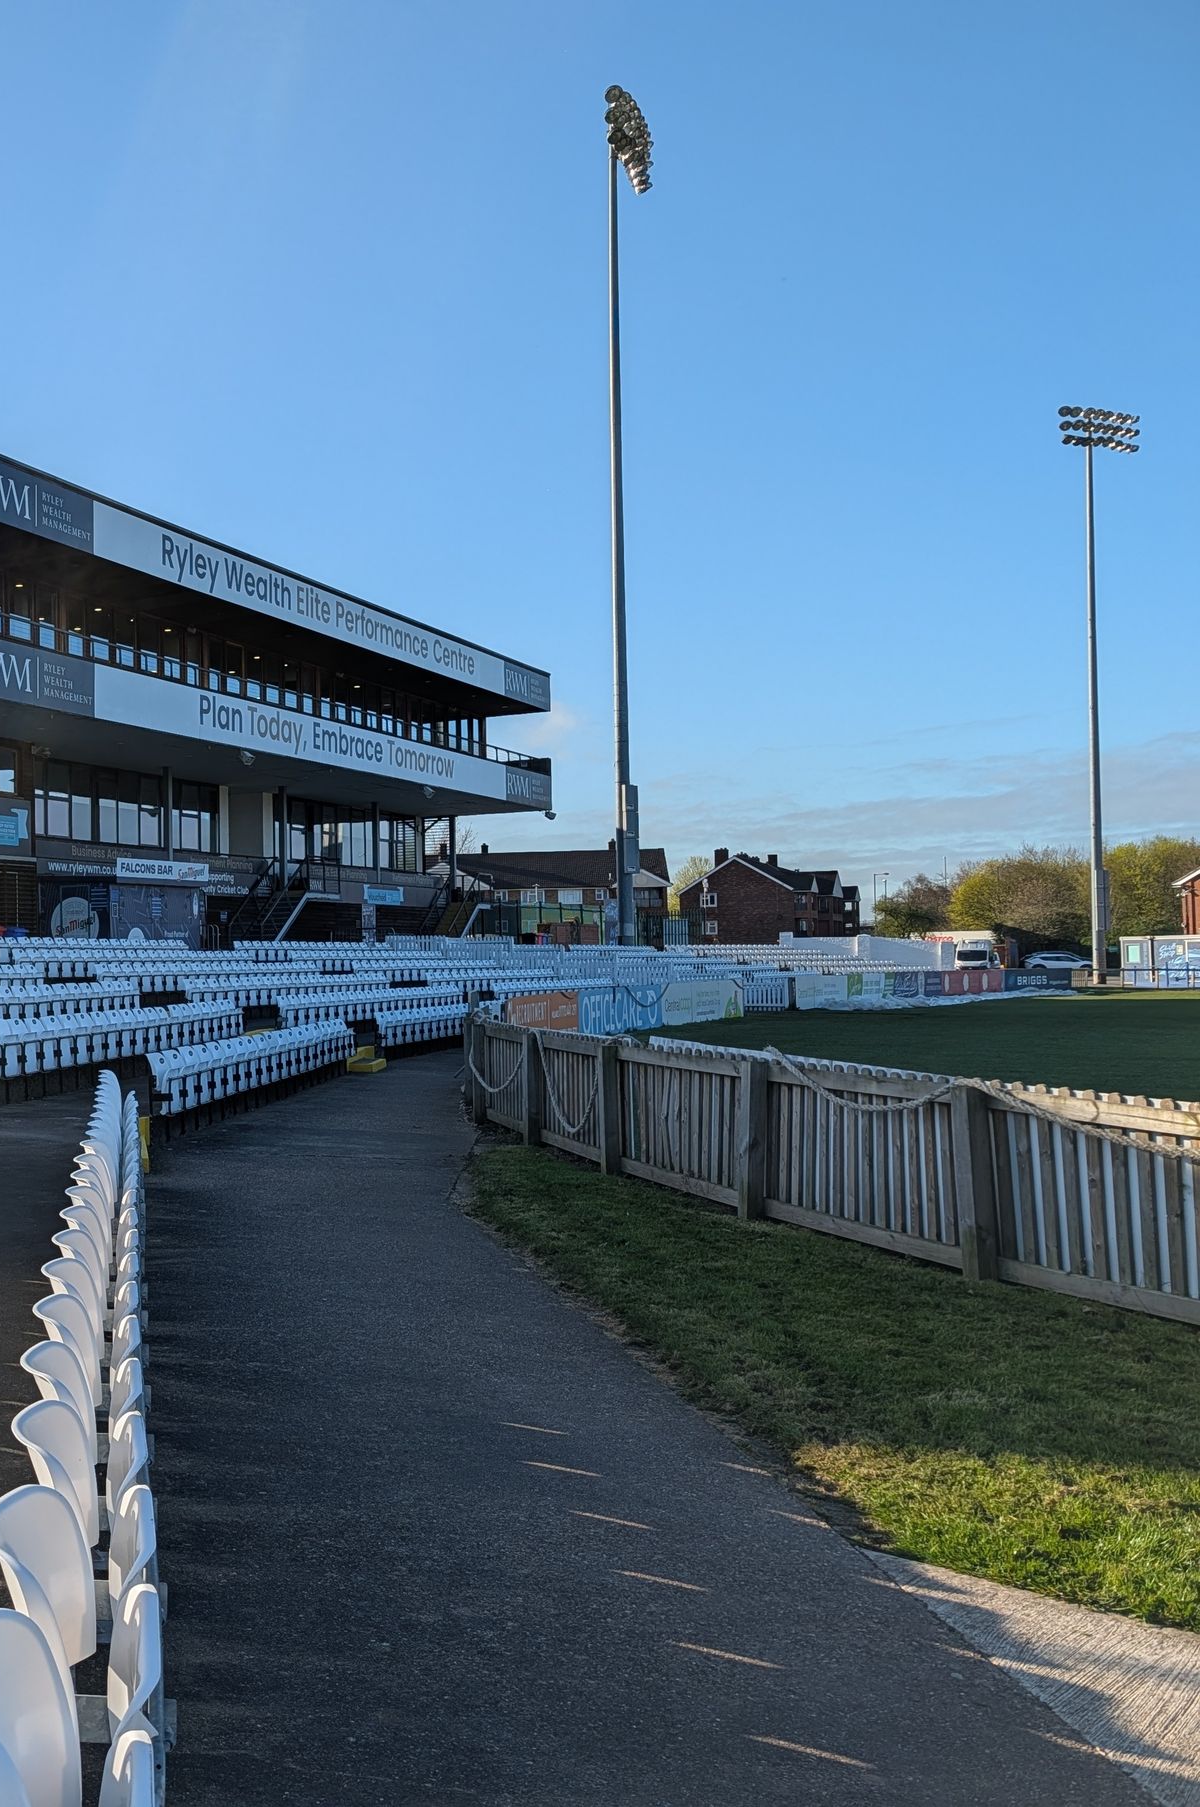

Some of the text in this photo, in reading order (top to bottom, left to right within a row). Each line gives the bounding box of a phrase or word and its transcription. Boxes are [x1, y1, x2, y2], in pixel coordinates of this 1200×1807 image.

[42, 492, 64, 508] RYLEY
[42, 504, 72, 522] WEALTH
[42, 517, 90, 542] MANAGEMENT
[162, 534, 475, 676] Ryley Wealth Elite Performance Centre
[44, 663, 66, 676] RYLEY
[44, 676, 73, 690] WEALTH
[506, 669, 527, 696] RWM
[44, 687, 92, 706] MANAGEMENT
[199, 694, 455, 779] Plan Today, Embrace Tomorrow
[508, 773, 528, 798] RWM
[72, 845, 105, 858] Business
[48, 862, 117, 876] www.ryleywm.co.u
[120, 862, 173, 875] FALCONS BAR
[217, 885, 236, 894] Cricket
[237, 886, 249, 895] Club
[1017, 976, 1047, 985] BRIGGS
